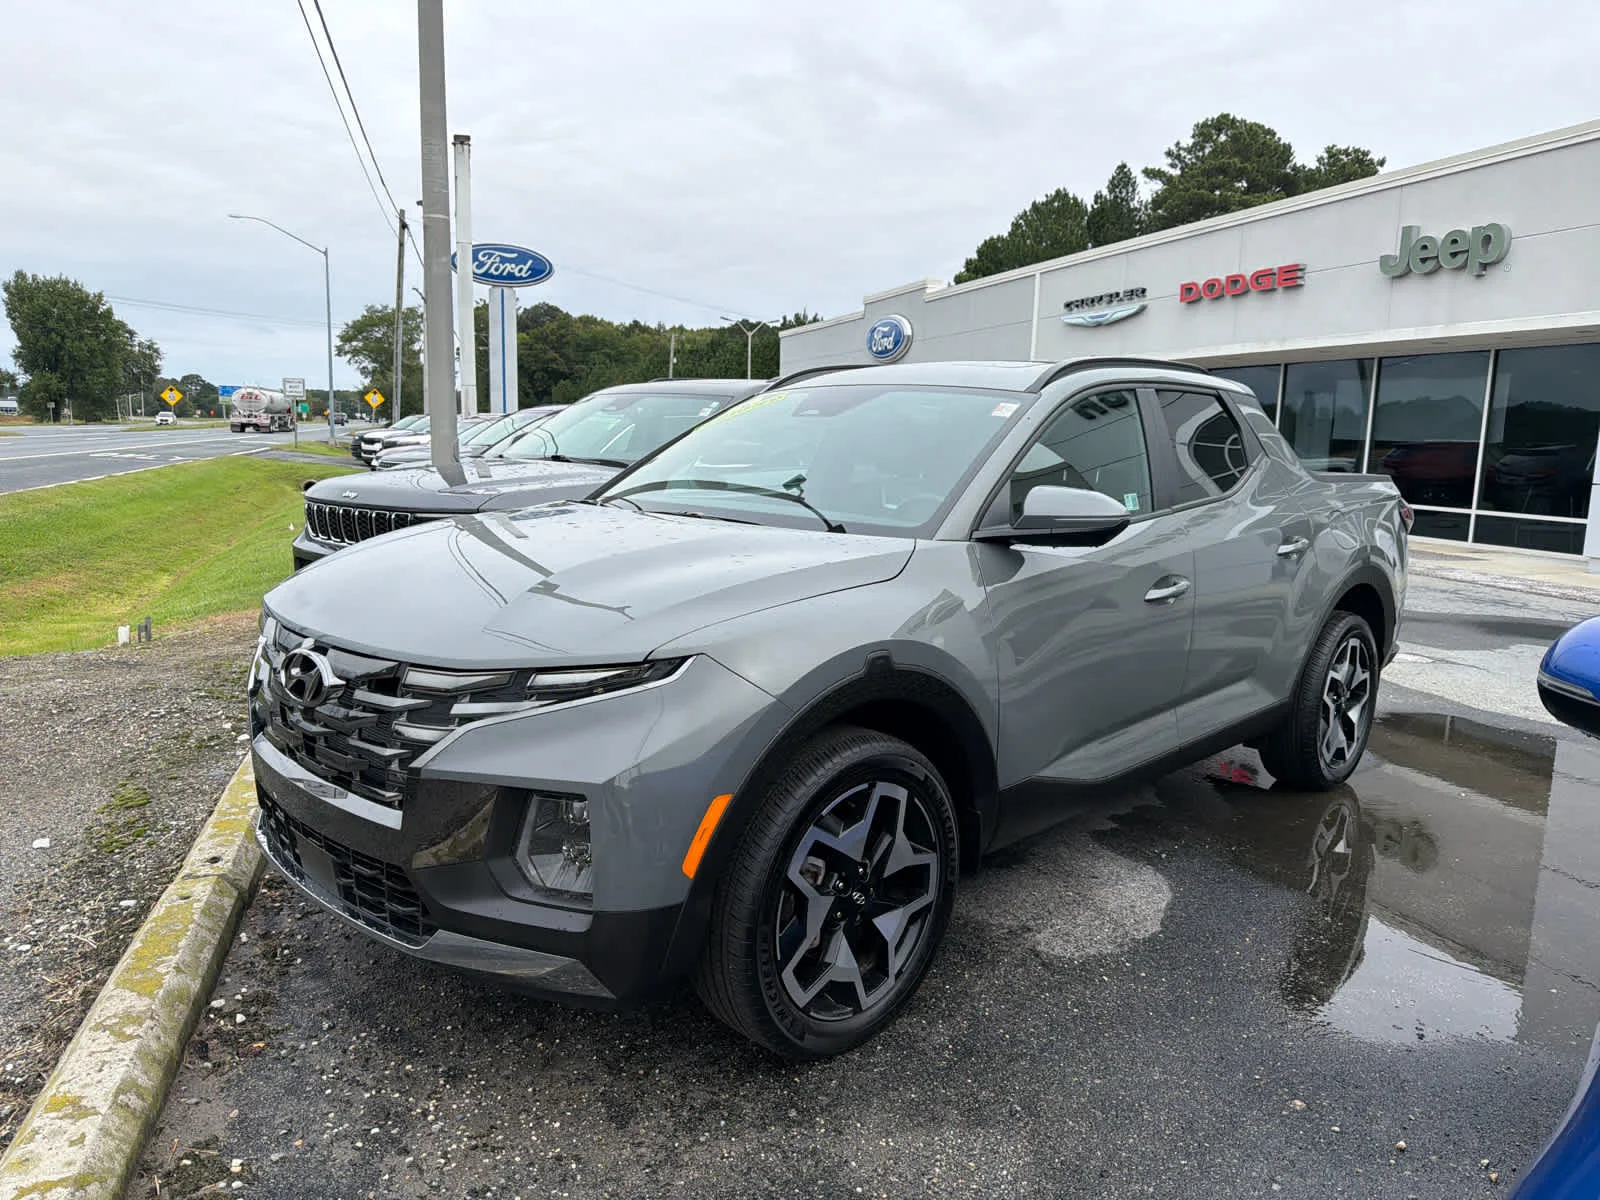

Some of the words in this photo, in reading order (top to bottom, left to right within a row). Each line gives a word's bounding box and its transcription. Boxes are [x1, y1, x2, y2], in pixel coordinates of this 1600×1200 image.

[472, 250, 534, 278] Ford
[1380, 222, 1511, 278] Jeep
[1179, 263, 1304, 303] DODGE
[872, 326, 895, 352] Ford
